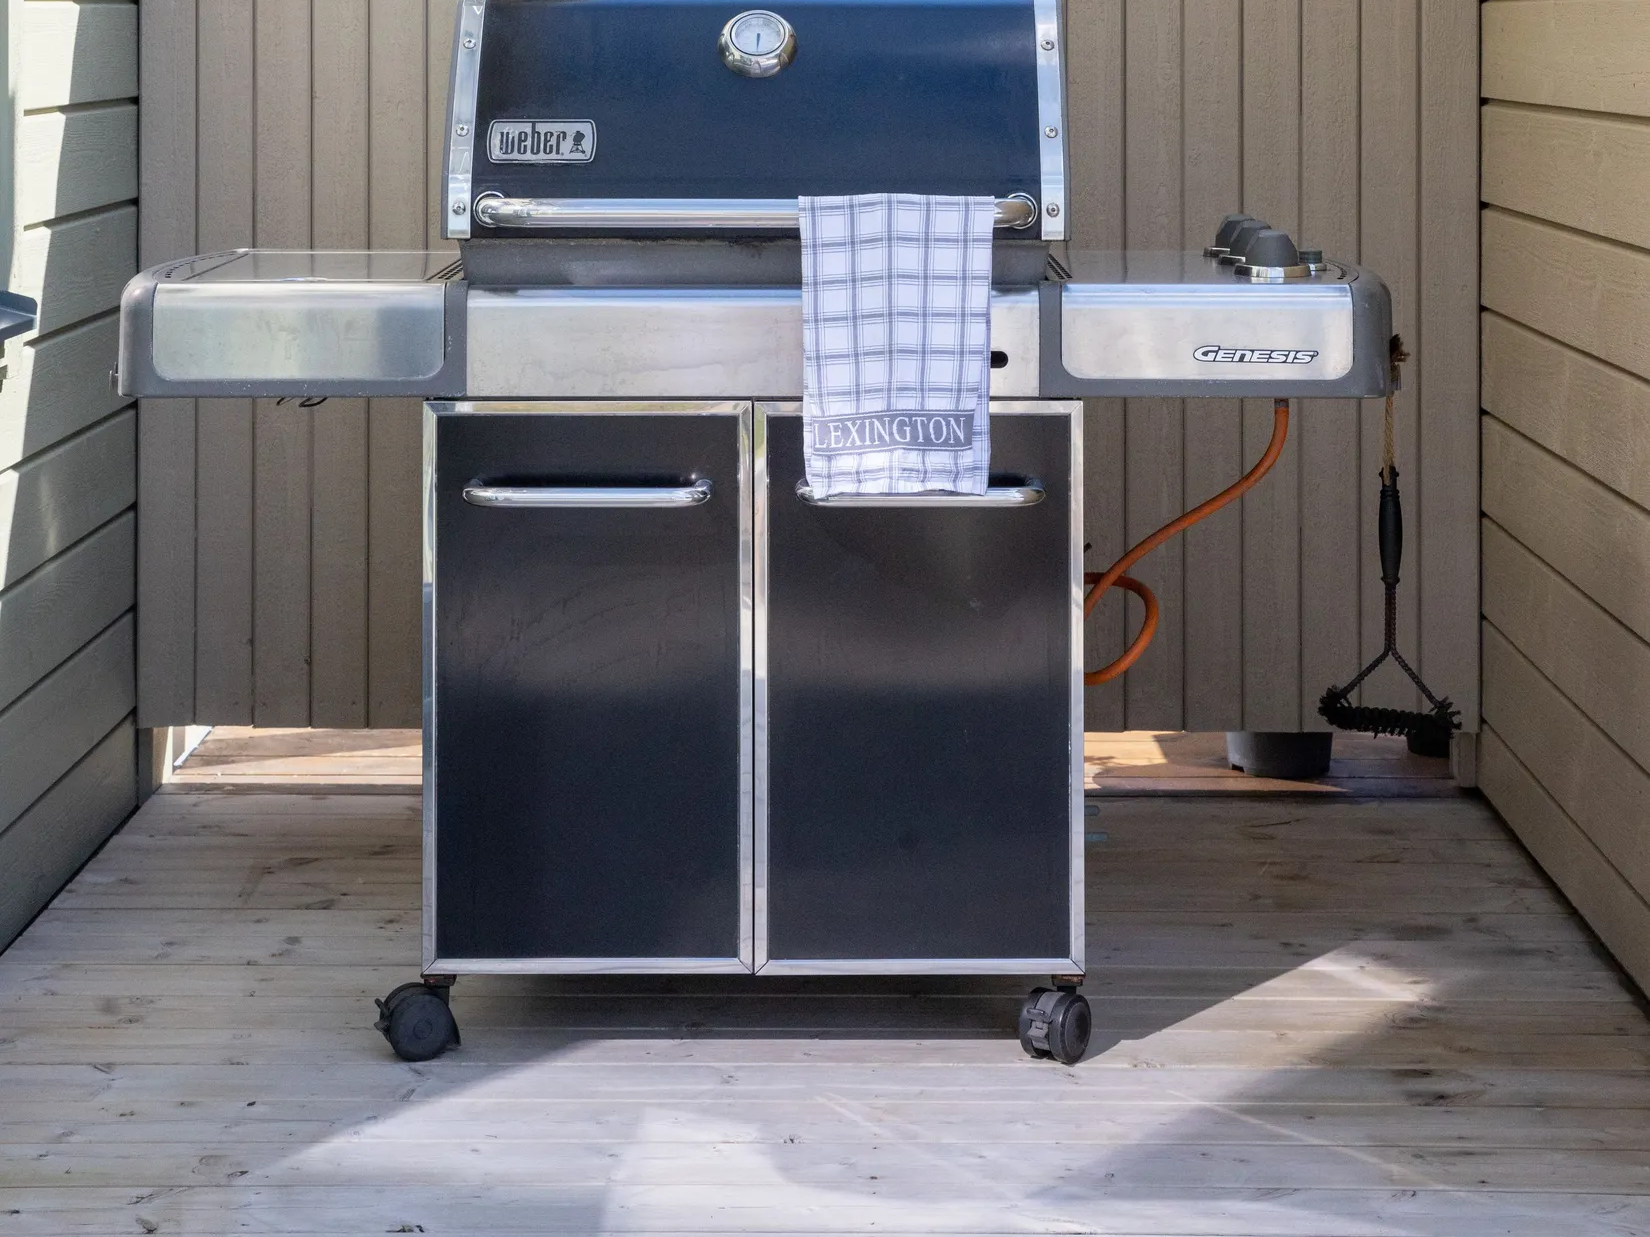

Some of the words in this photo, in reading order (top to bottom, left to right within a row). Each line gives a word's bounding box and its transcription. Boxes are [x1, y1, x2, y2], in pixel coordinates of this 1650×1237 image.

[499, 123, 567, 155] weber
[1193, 345, 1318, 364] GENESIS
[813, 417, 966, 449] LEXINGTON
